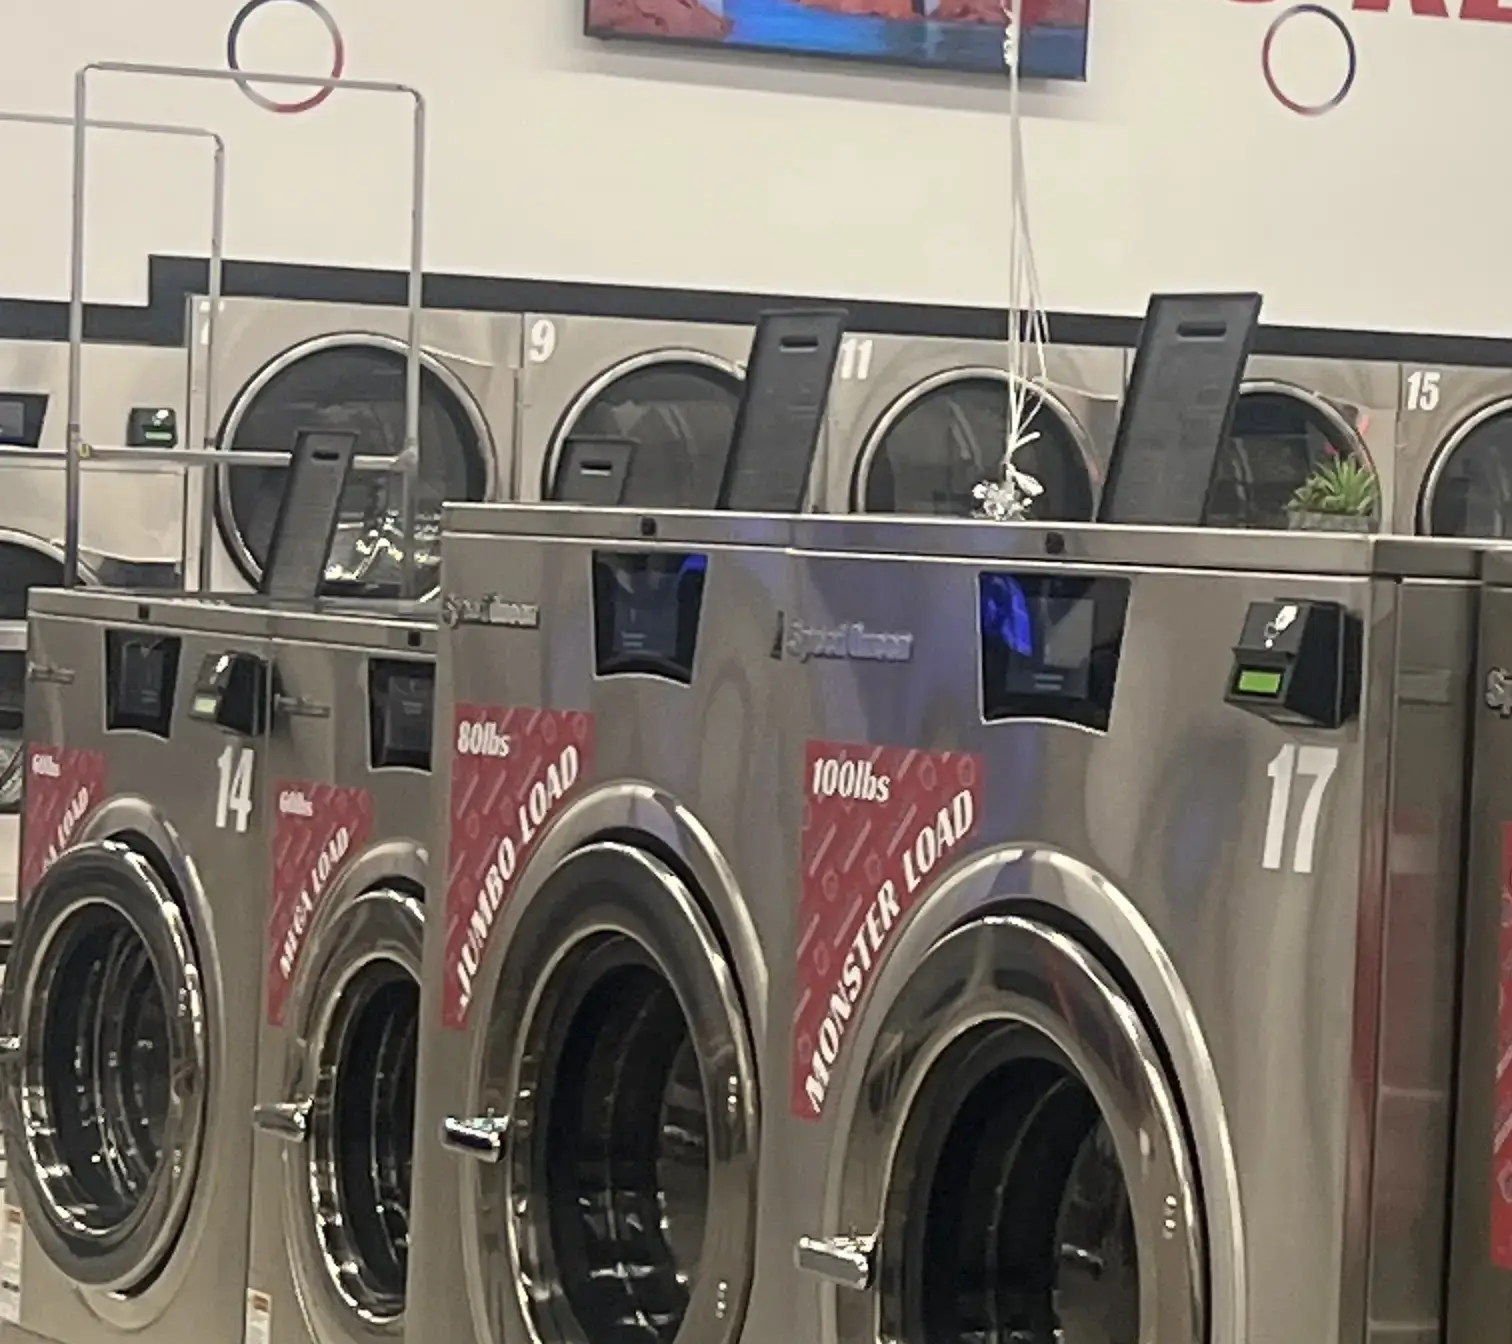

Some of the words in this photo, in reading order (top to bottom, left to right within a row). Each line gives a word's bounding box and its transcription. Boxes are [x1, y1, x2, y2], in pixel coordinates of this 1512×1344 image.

[529, 319, 556, 362] 9
[841, 339, 873, 380] 11
[1405, 370, 1441, 412] 15
[457, 720, 511, 758] 80lbs
[216, 746, 254, 832] 14
[811, 757, 891, 805] 100lbs
[1261, 743, 1339, 873] 17
[456, 835, 517, 1024] JUMBO
[517, 744, 581, 845] LOAD
[804, 878, 902, 1113] MONSTER
[901, 788, 977, 894] LOAD
